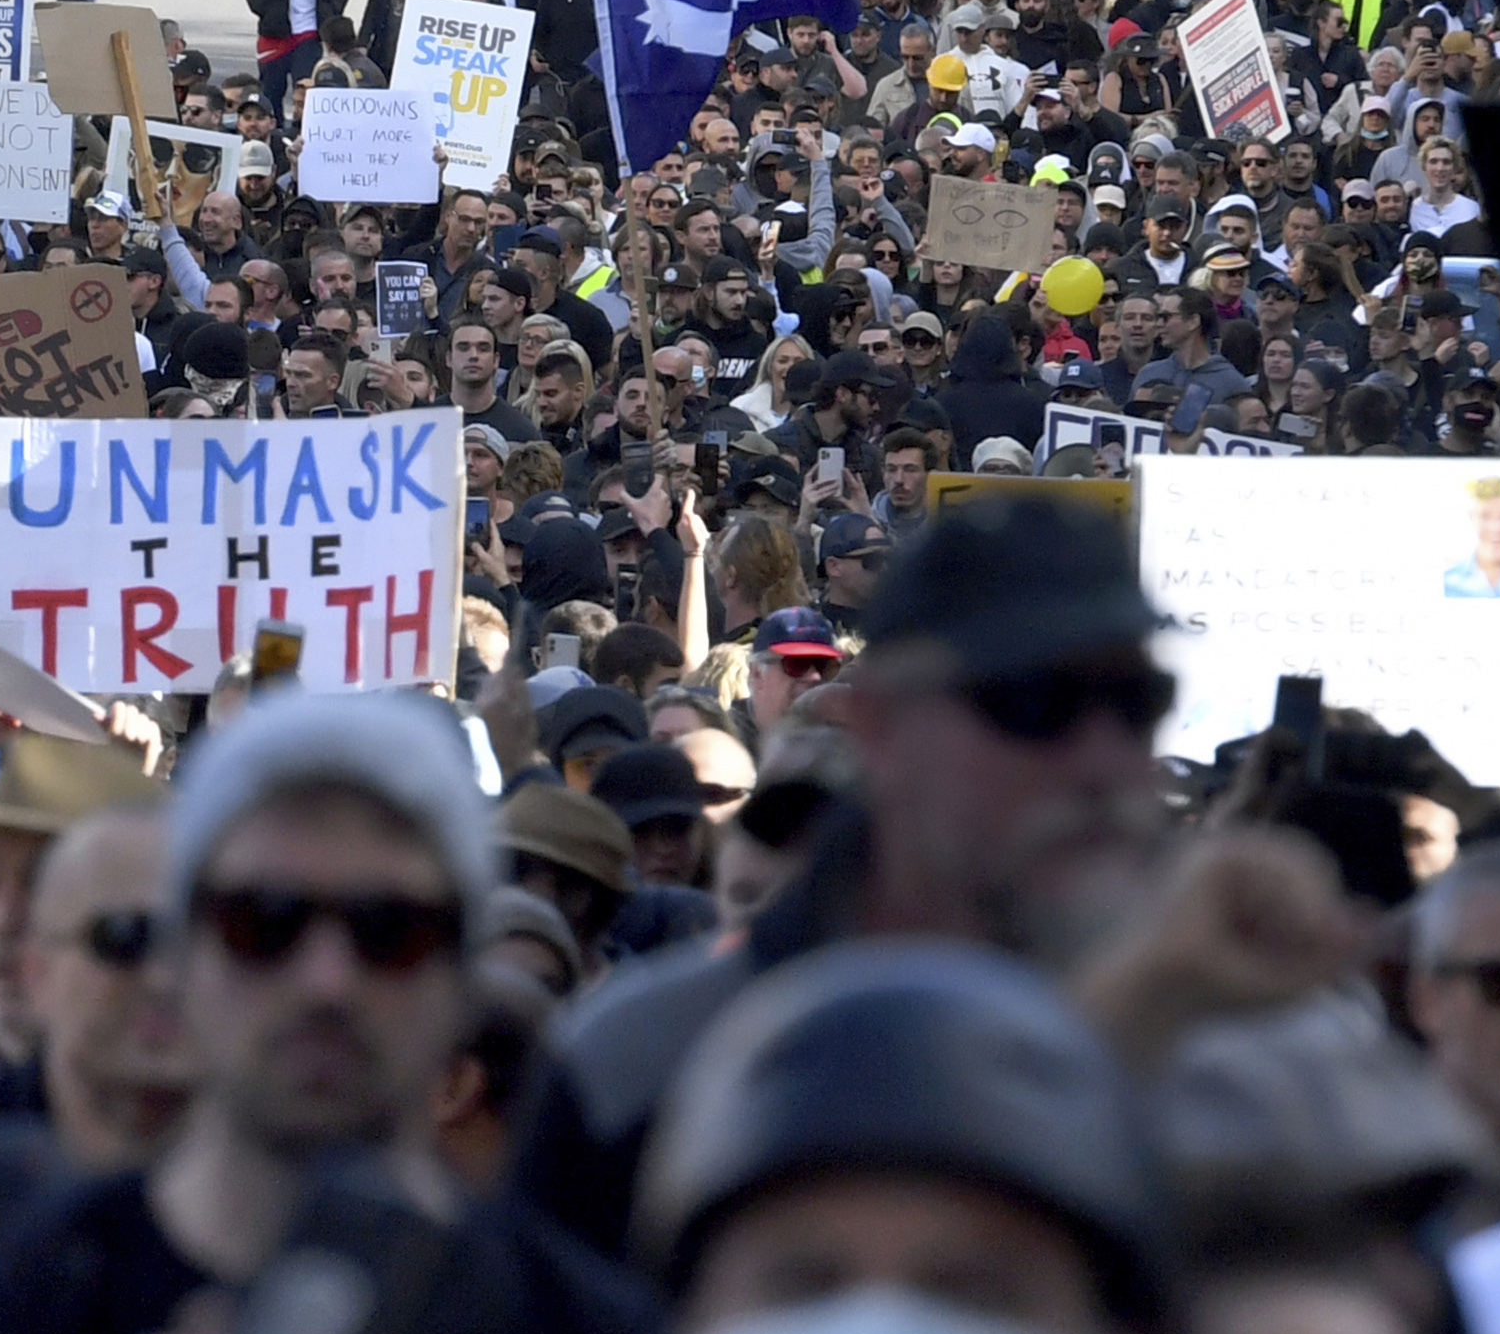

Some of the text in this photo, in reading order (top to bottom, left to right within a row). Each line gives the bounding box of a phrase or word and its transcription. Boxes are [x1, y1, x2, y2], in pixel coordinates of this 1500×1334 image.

[419, 15, 516, 54] RISE UP
[412, 35, 511, 78] SPEAK
[450, 69, 507, 116] UP
[1212, 92, 1233, 117] SICK
[311, 95, 418, 121] LOCKDOWNS
[308, 126, 414, 143] HURT MORE
[322, 152, 399, 165] THAN THEY
[342, 172, 378, 188] HELP!
[384, 275, 421, 288] YOU CAN
[388, 290, 419, 302] SAY NO
[9, 421, 447, 527] UNMASK
[130, 534, 341, 580] THE
[11, 569, 434, 684] TRUTH
[1229, 612, 1408, 635] POSSIBLE
